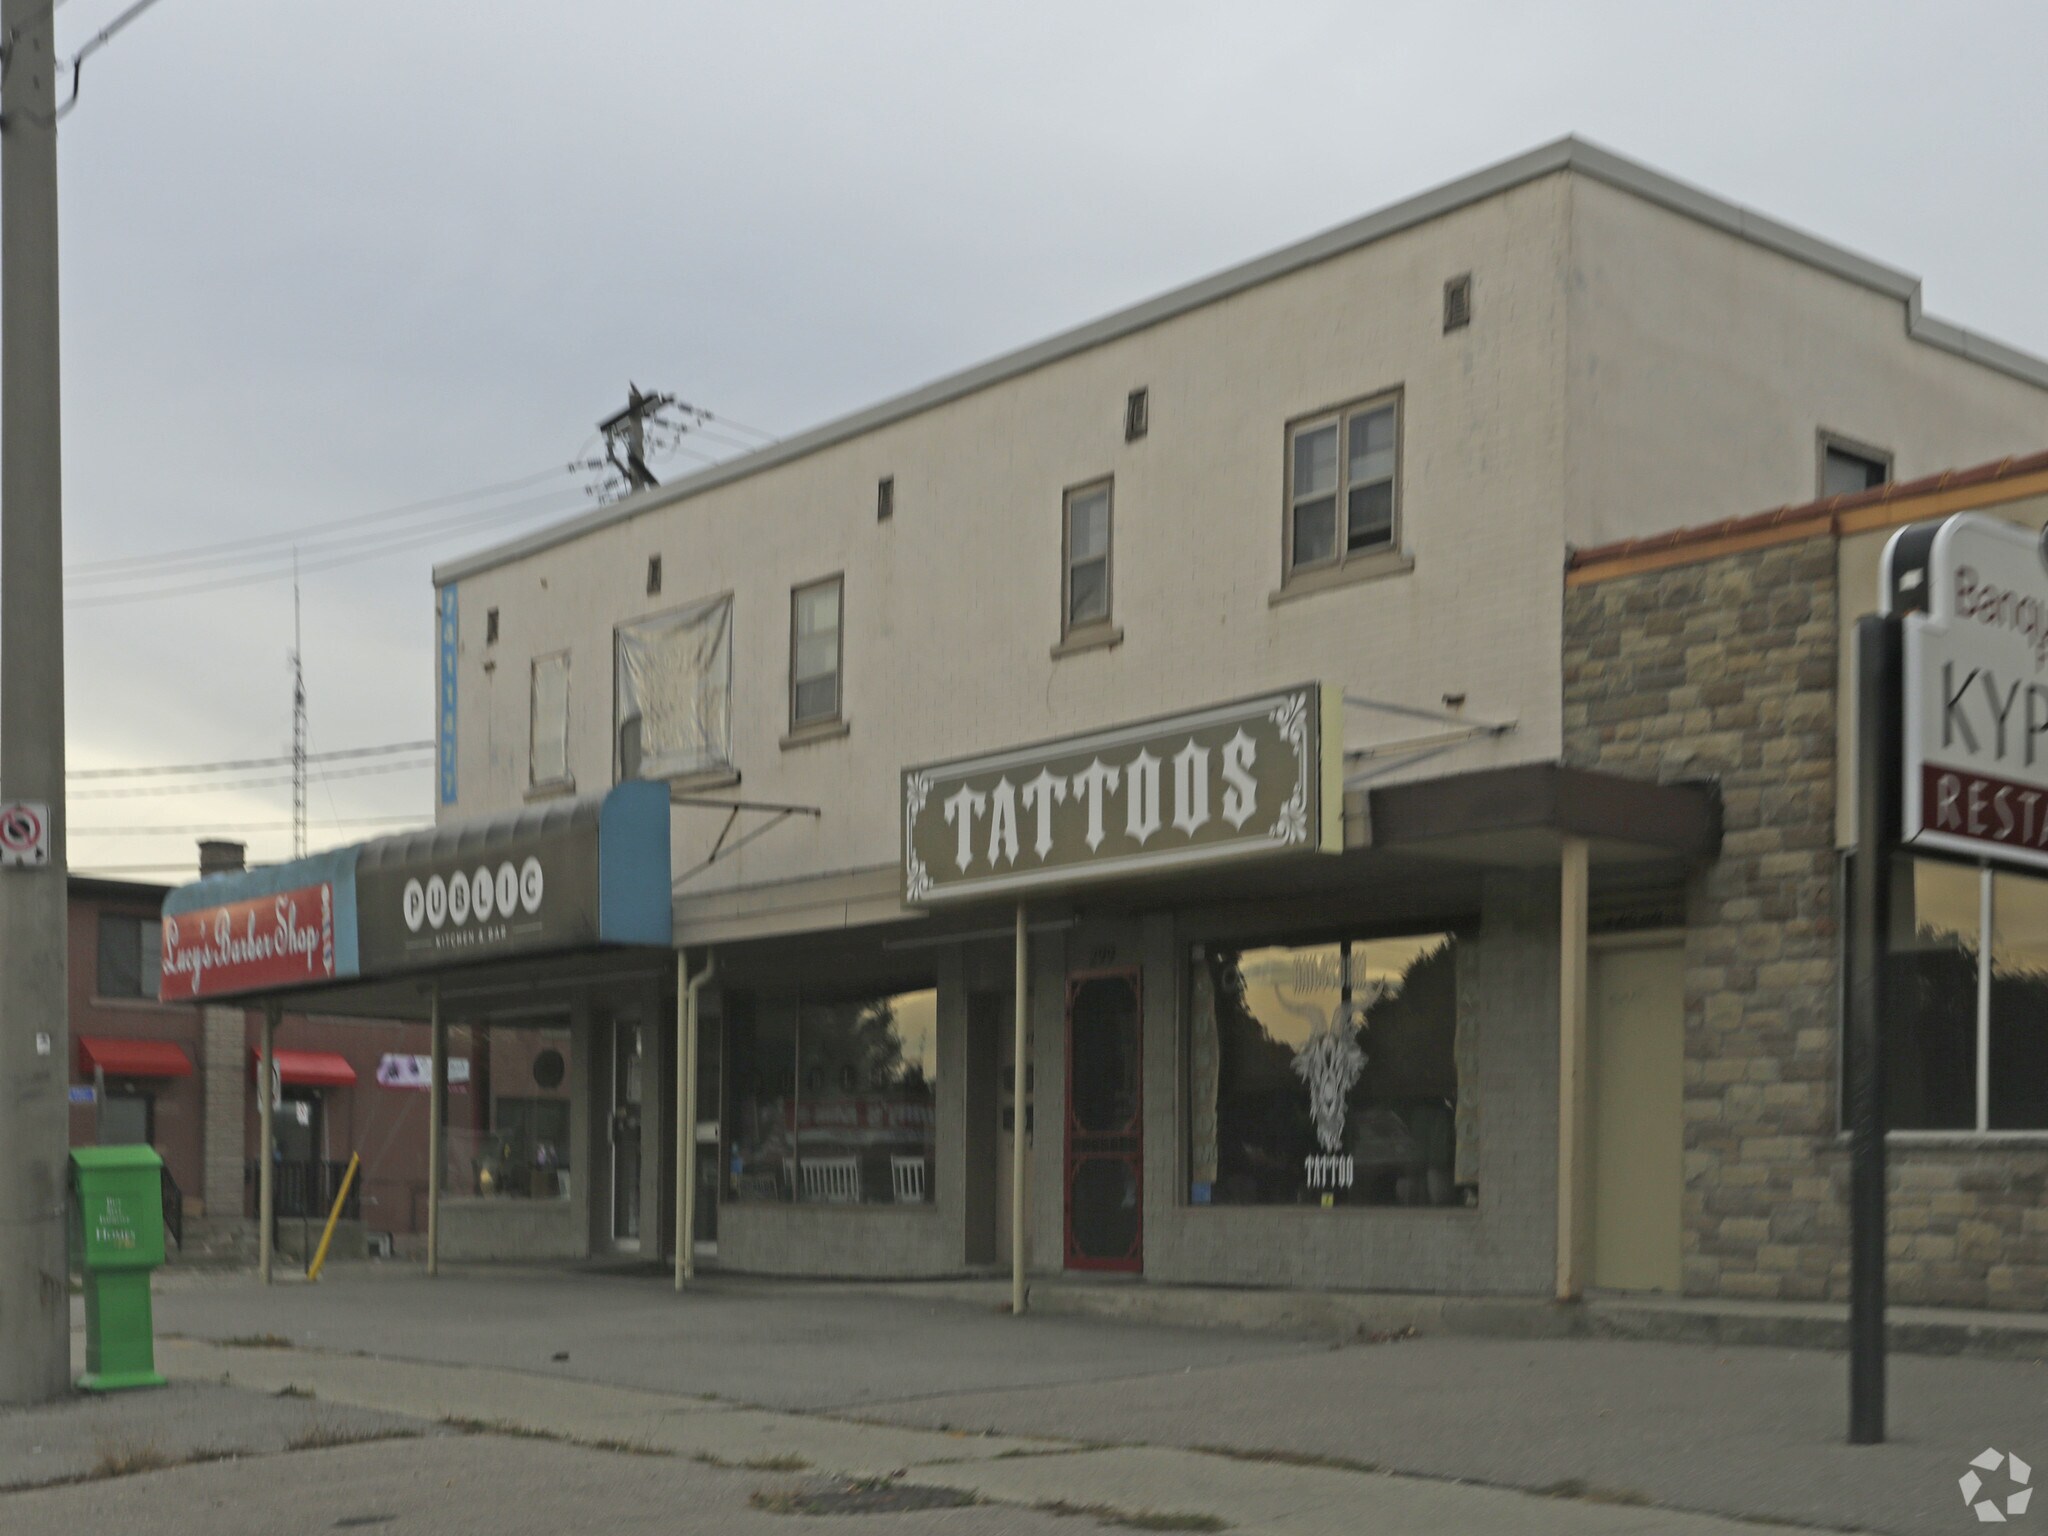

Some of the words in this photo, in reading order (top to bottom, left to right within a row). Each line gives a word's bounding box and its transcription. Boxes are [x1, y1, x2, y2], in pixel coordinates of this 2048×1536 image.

[1954, 564, 2048, 649] Banq
[1941, 660, 2048, 767] KYP
[943, 727, 1259, 874] TATTOOS
[403, 856, 543, 931] PUBLIC
[161, 915, 213, 995] Lucy's
[213, 907, 273, 968] Barber
[274, 894, 320, 973] Shop
[435, 929, 475, 950] KITCHEN
[488, 924, 507, 944] BAR
[1304, 1153, 1353, 1190] TATTOO
